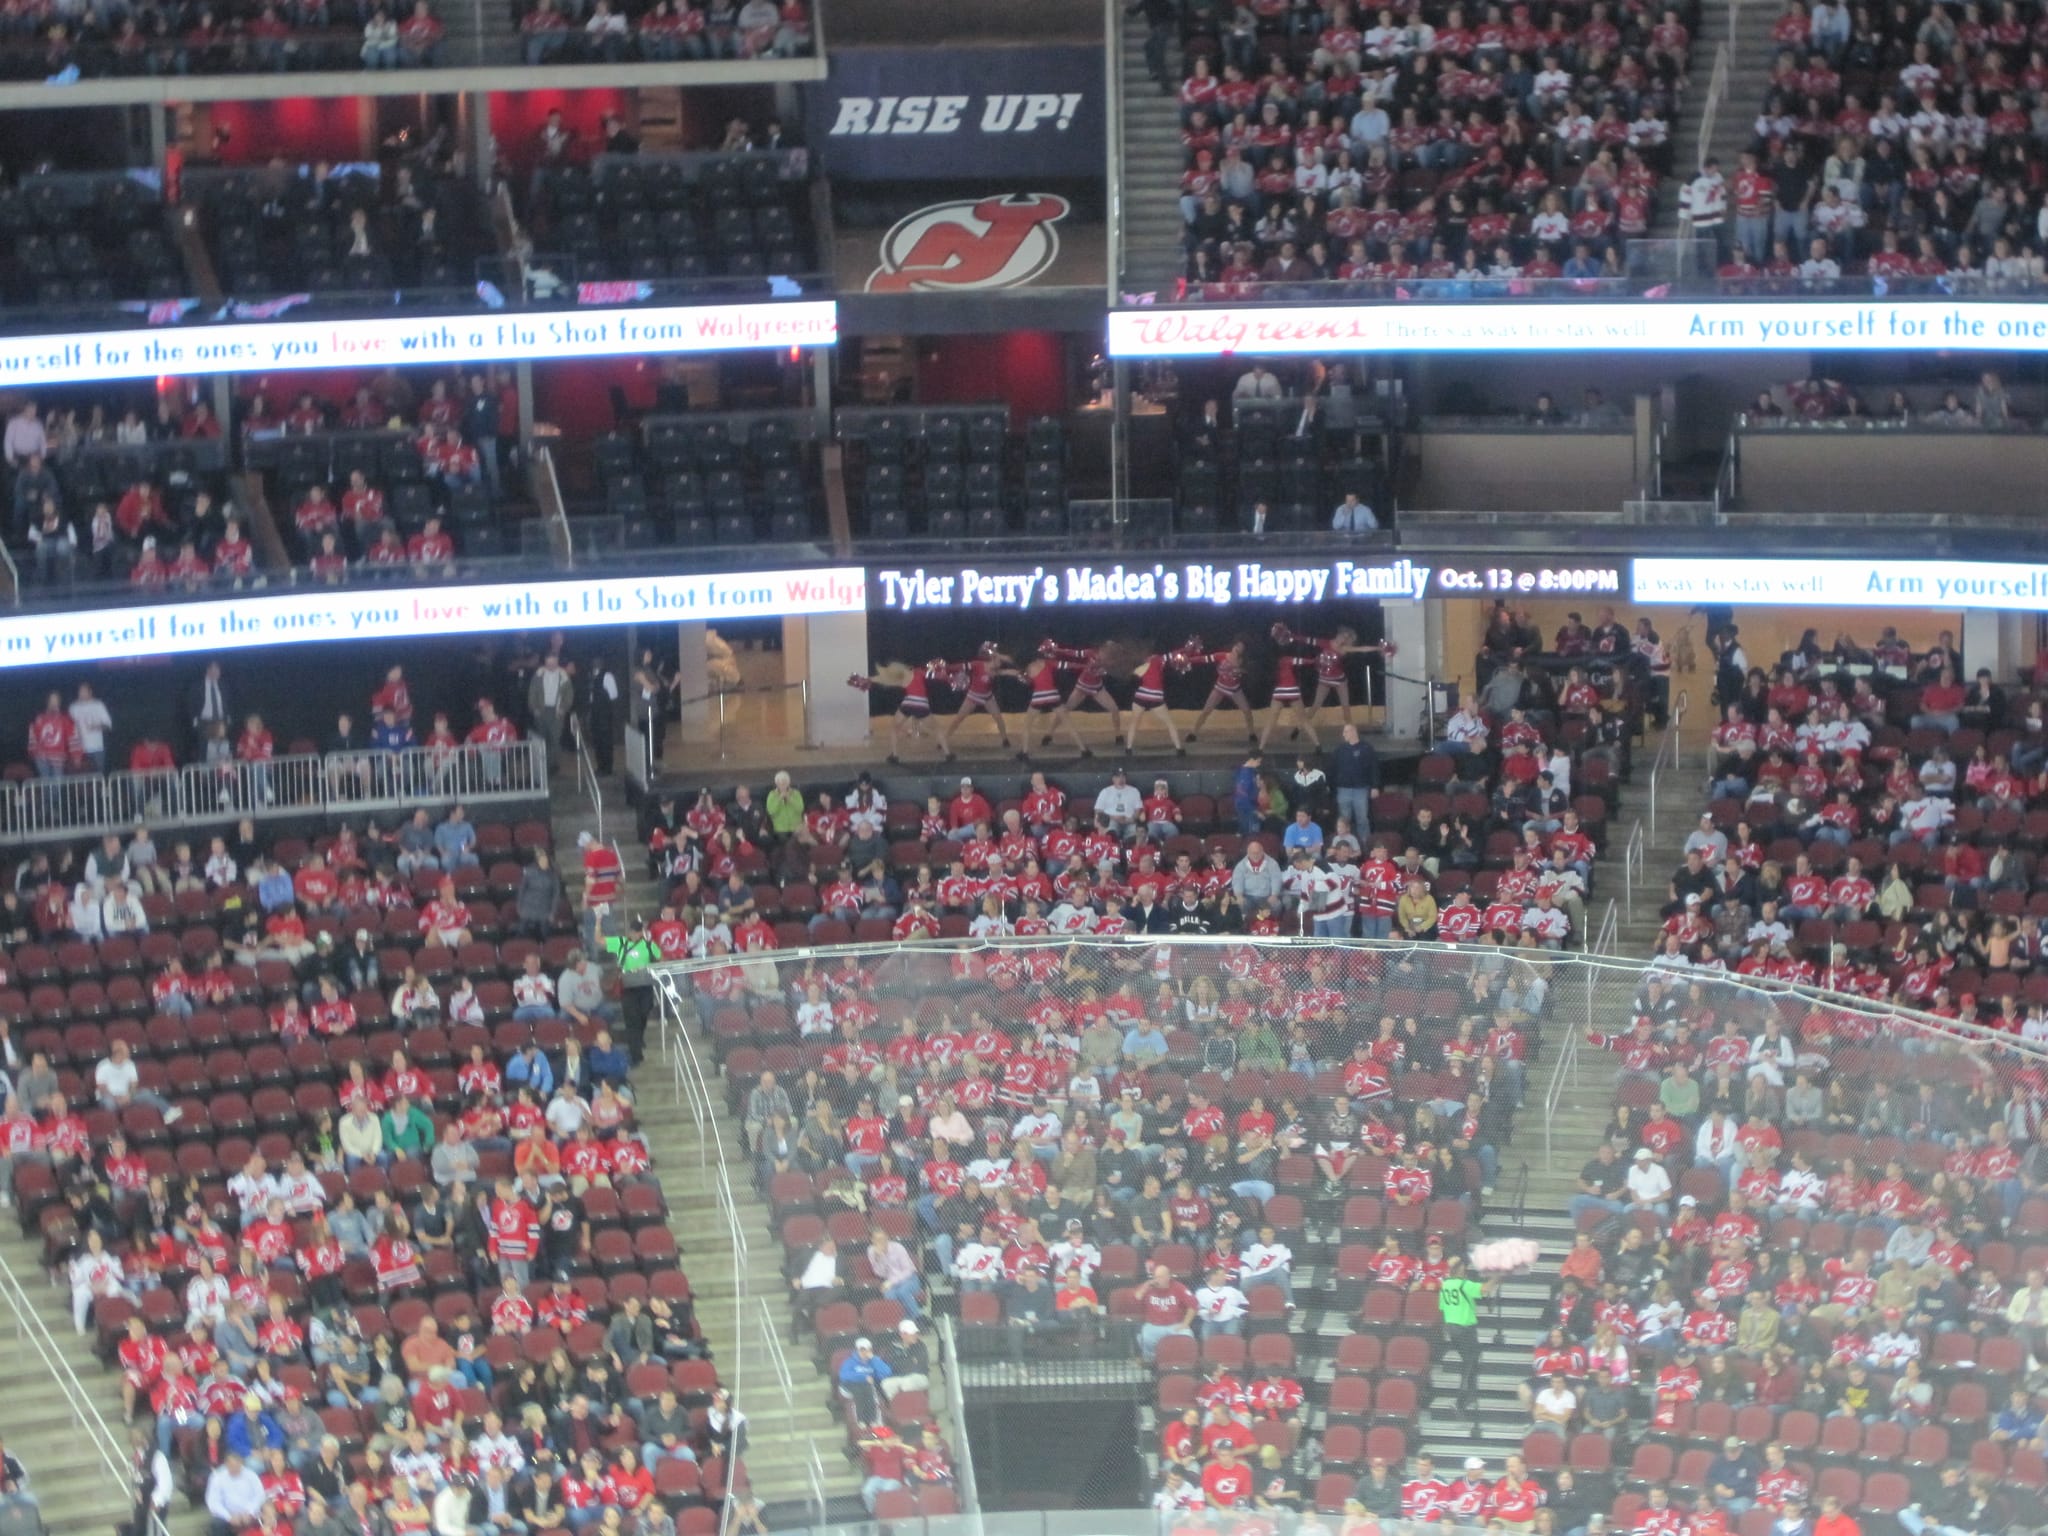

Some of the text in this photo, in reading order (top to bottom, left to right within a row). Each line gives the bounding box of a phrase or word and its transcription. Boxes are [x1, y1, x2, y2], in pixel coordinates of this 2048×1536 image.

[829, 93, 1083, 136] RISE UP!
[94, 341, 130, 366] for
[144, 338, 184, 363] the
[196, 342, 257, 360] ones
[272, 340, 319, 362] you
[332, 331, 387, 353] love
[400, 324, 457, 350] with
[468, 331, 484, 348] a
[496, 321, 536, 347] Flu
[548, 319, 608, 344] Shot
[619, 316, 683, 342] from
[697, 313, 838, 342] Walgreens
[1132, 314, 1367, 349] Walgreens
[1604, 319, 1649, 338] well
[1689, 313, 1745, 337] Arm
[1759, 310, 1877, 342] yourself
[1888, 309, 1929, 337] for
[1943, 309, 1985, 337] the
[879, 558, 1431, 611] Tyler Perry's Madea's Big Happy Family
[1439, 567, 1620, 592] Oct. 13 @ 8:00PM
[1781, 574, 1824, 593] well
[1866, 570, 2048, 600] Arm yourself
[44, 616, 156, 653] yourself
[169, 613, 206, 639] for
[219, 609, 262, 635] the
[273, 612, 337, 631] ones
[350, 608, 400, 630] you
[412, 599, 469, 622] love
[482, 591, 541, 618] with
[553, 598, 569, 615] a
[582, 586, 623, 613] Flu
[635, 584, 697, 610] Shot
[707, 581, 773, 607] from
